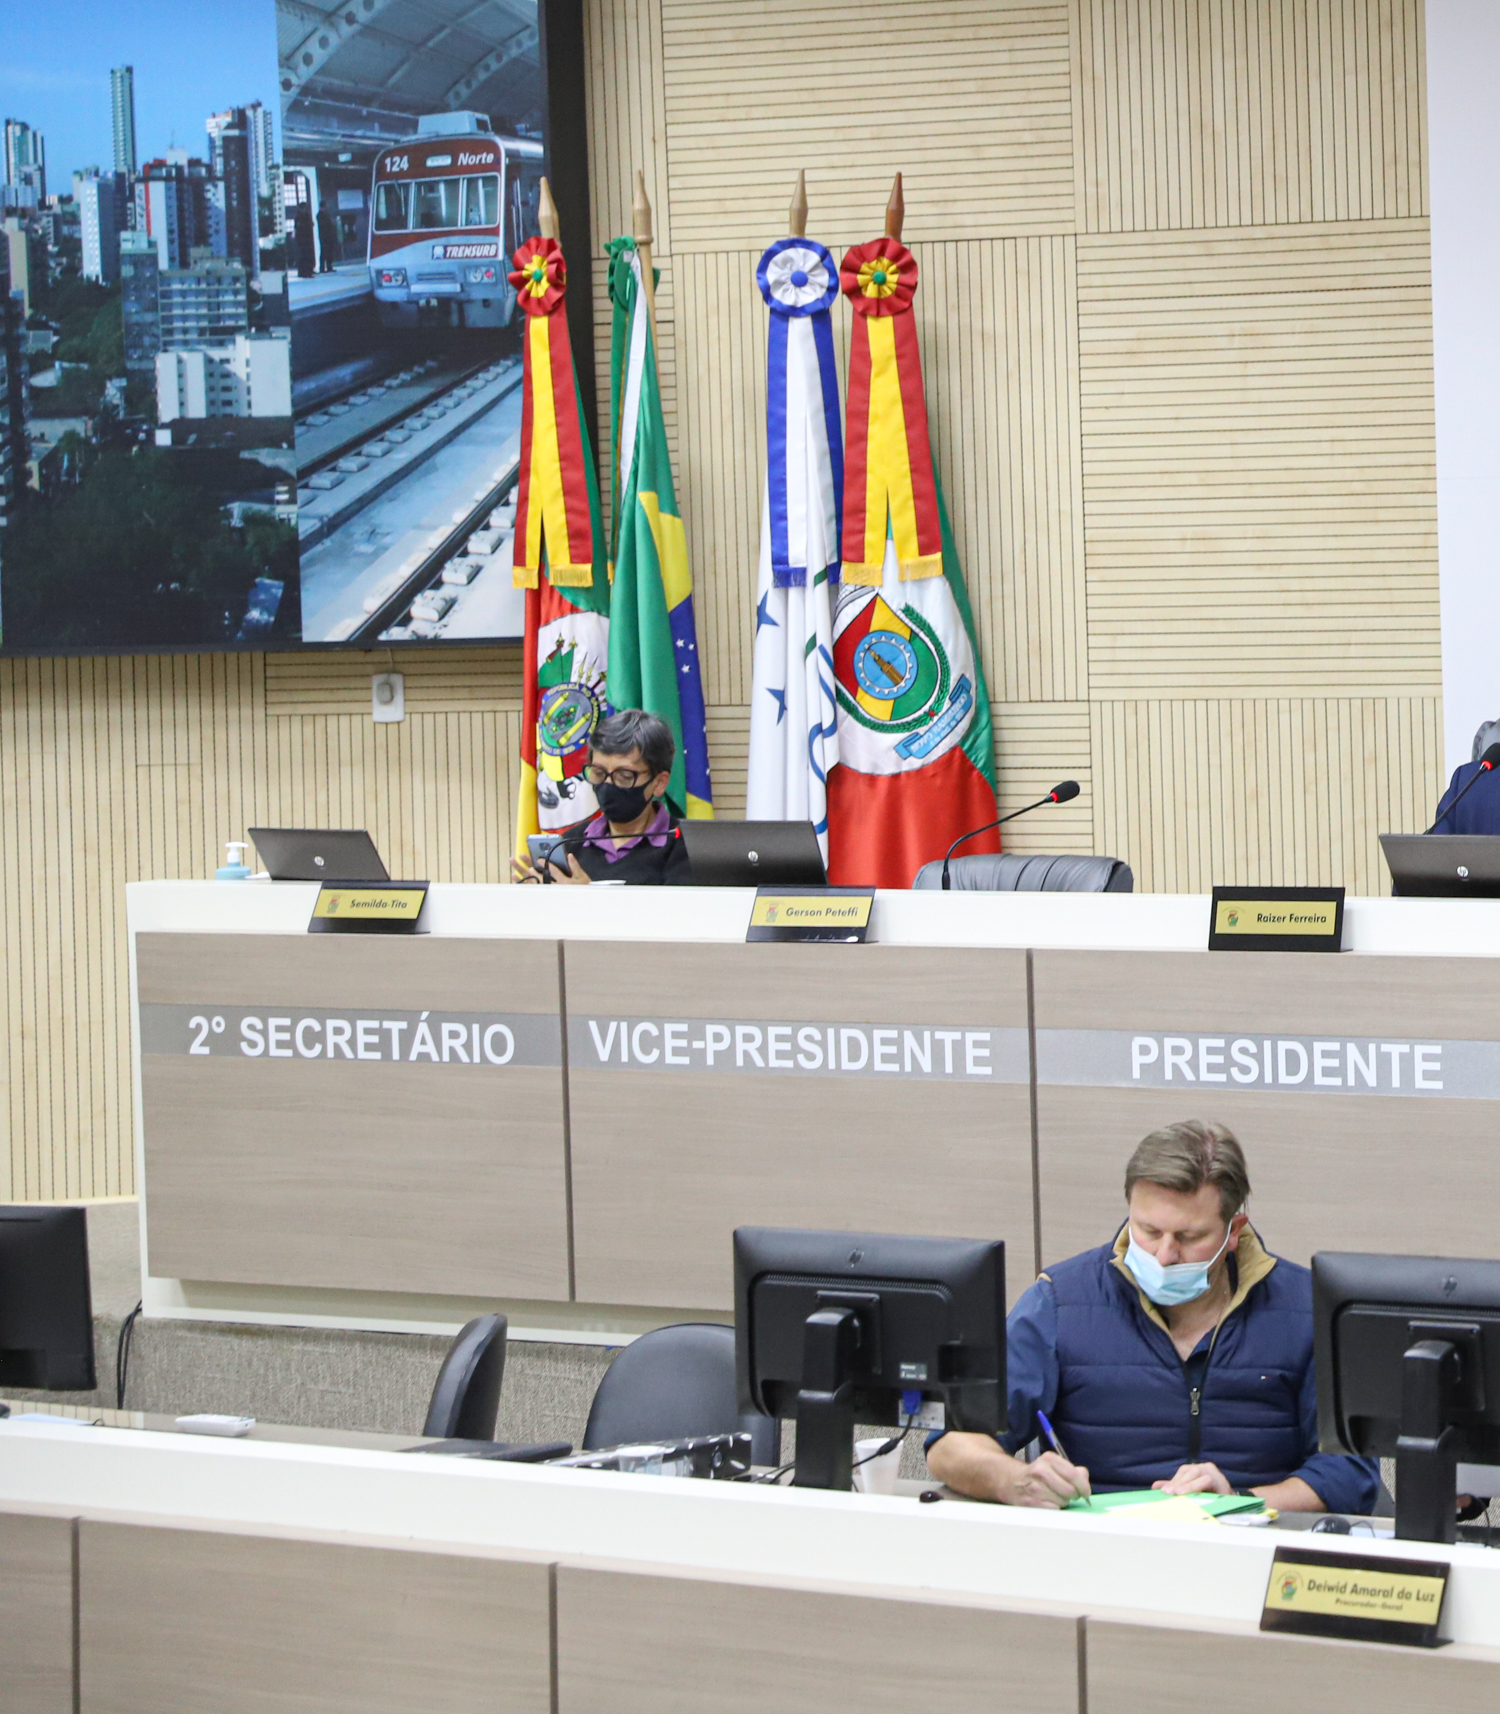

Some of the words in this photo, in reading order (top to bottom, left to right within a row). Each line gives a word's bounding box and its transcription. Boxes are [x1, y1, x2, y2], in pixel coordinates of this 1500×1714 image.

[384, 155, 409, 173] 124
[457, 151, 495, 166] Norte
[445, 244, 498, 258] TRENSURB
[350, 898, 388, 909] Semilda
[391, 899, 408, 909] Tita
[786, 906, 822, 917] Gerson
[825, 907, 859, 917] Peteffi
[1256, 912, 1287, 923] Raizer
[1289, 913, 1327, 923] Ferreira
[240, 1011, 515, 1065] SECRETÁRIO
[588, 1020, 993, 1075] VICE-PRESIDENTE
[1131, 1036, 1445, 1090] PRESIDENTE
[1307, 1579, 1347, 1594] Deiwid
[1350, 1583, 1394, 1598] Amaral
[1397, 1586, 1412, 1601] da
[1416, 1589, 1436, 1603] Luz
